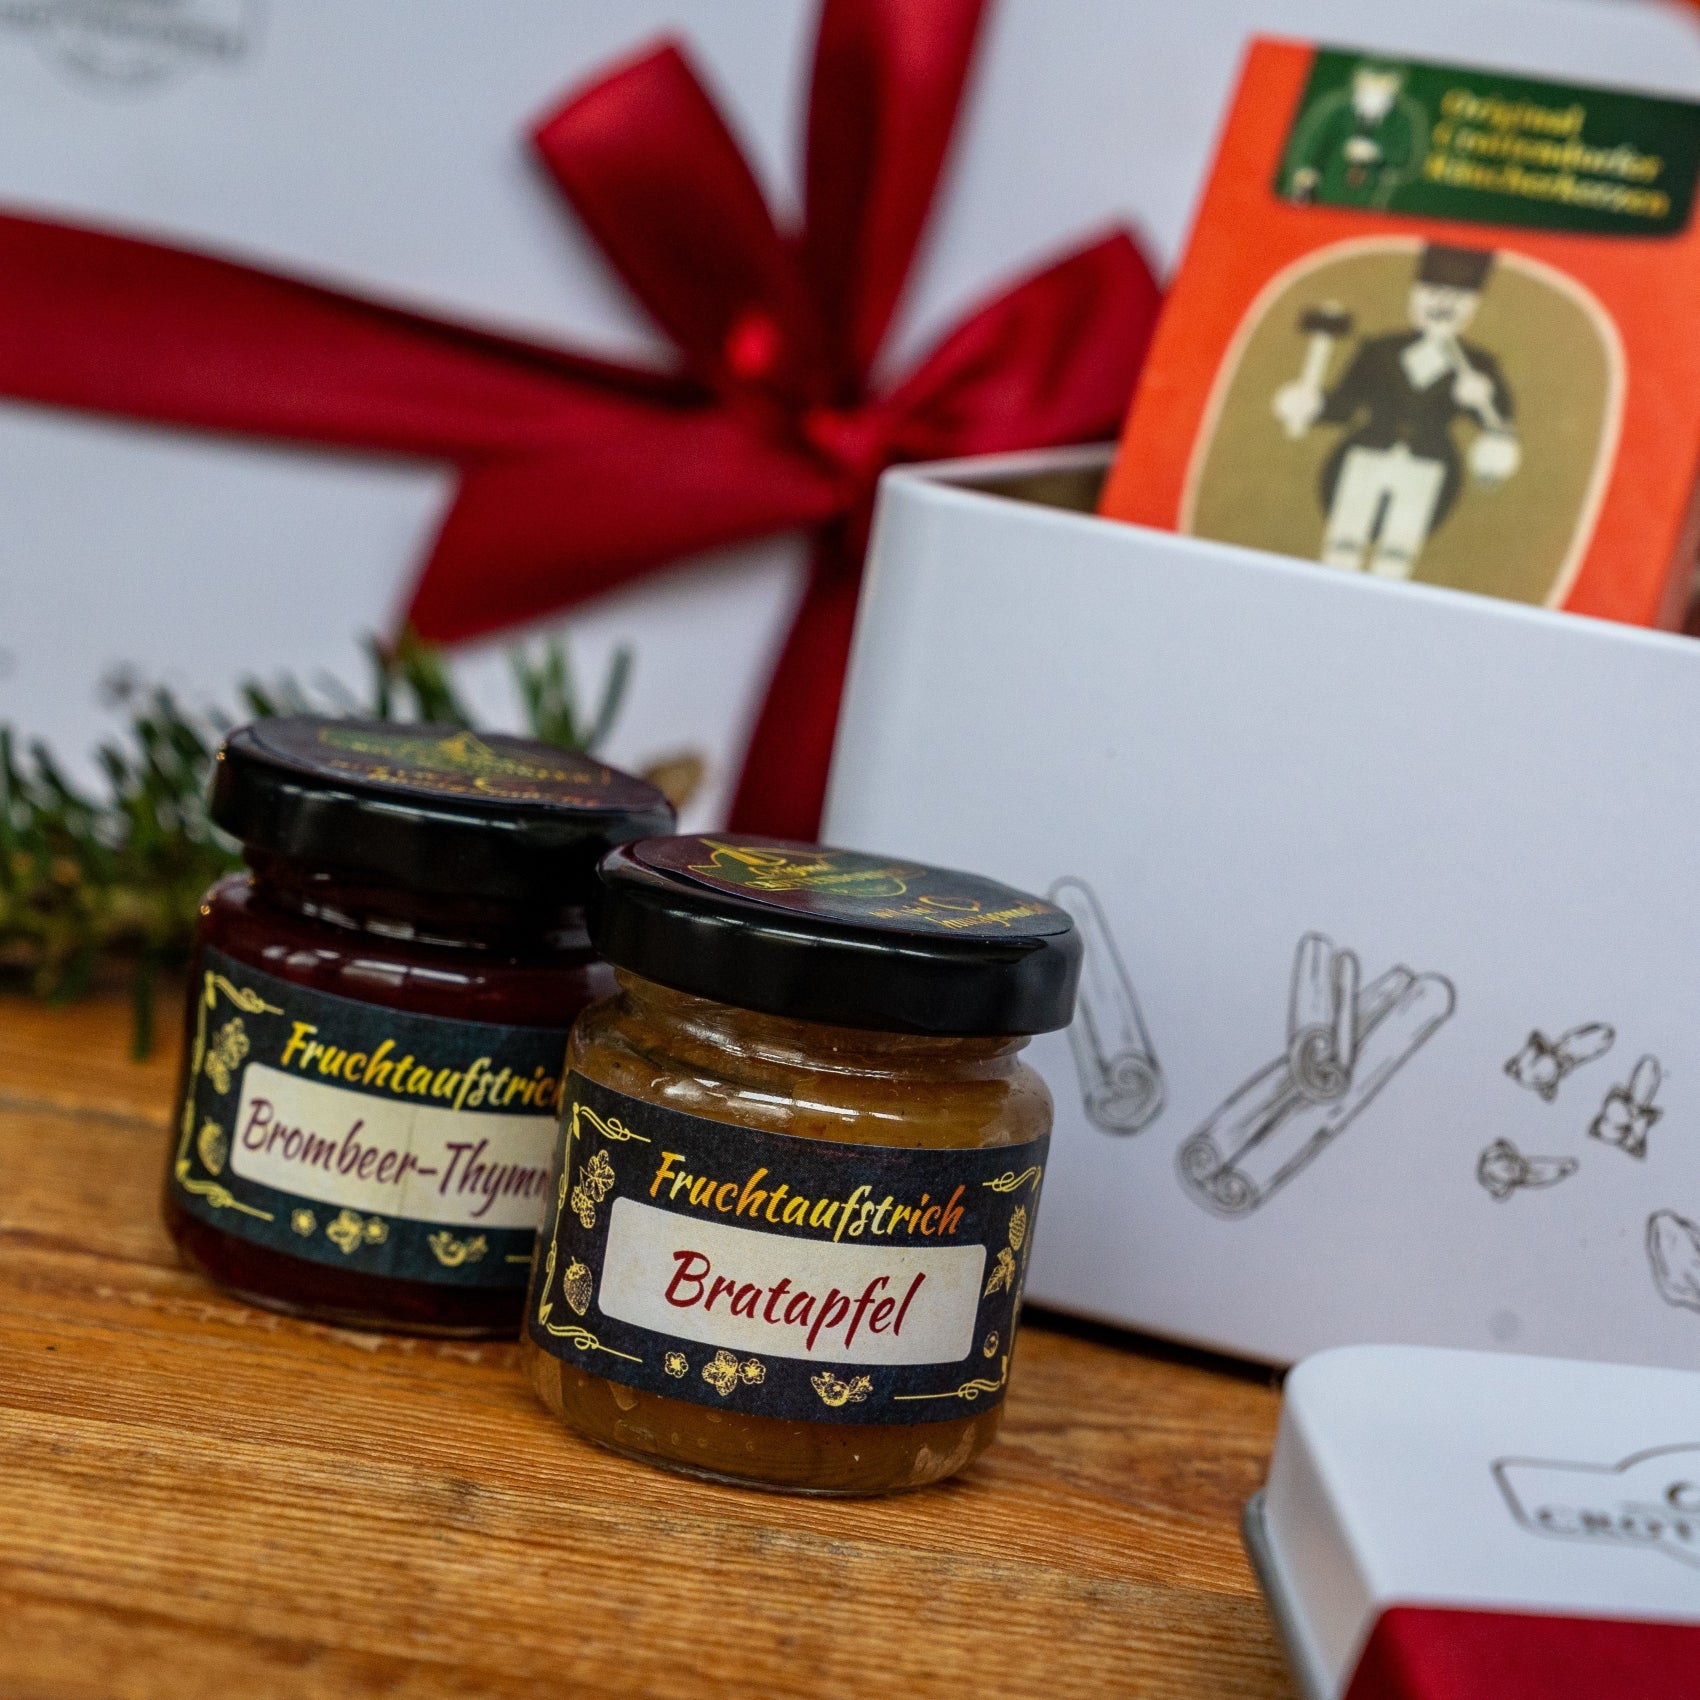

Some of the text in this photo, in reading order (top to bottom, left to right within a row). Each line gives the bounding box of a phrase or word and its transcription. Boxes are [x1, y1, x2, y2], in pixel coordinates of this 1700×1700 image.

[280, 1021, 562, 1112] Fruchtaufstric
[649, 1151, 966, 1243] Fruchtaufstrich
[663, 1250, 927, 1350] Bratapfel
